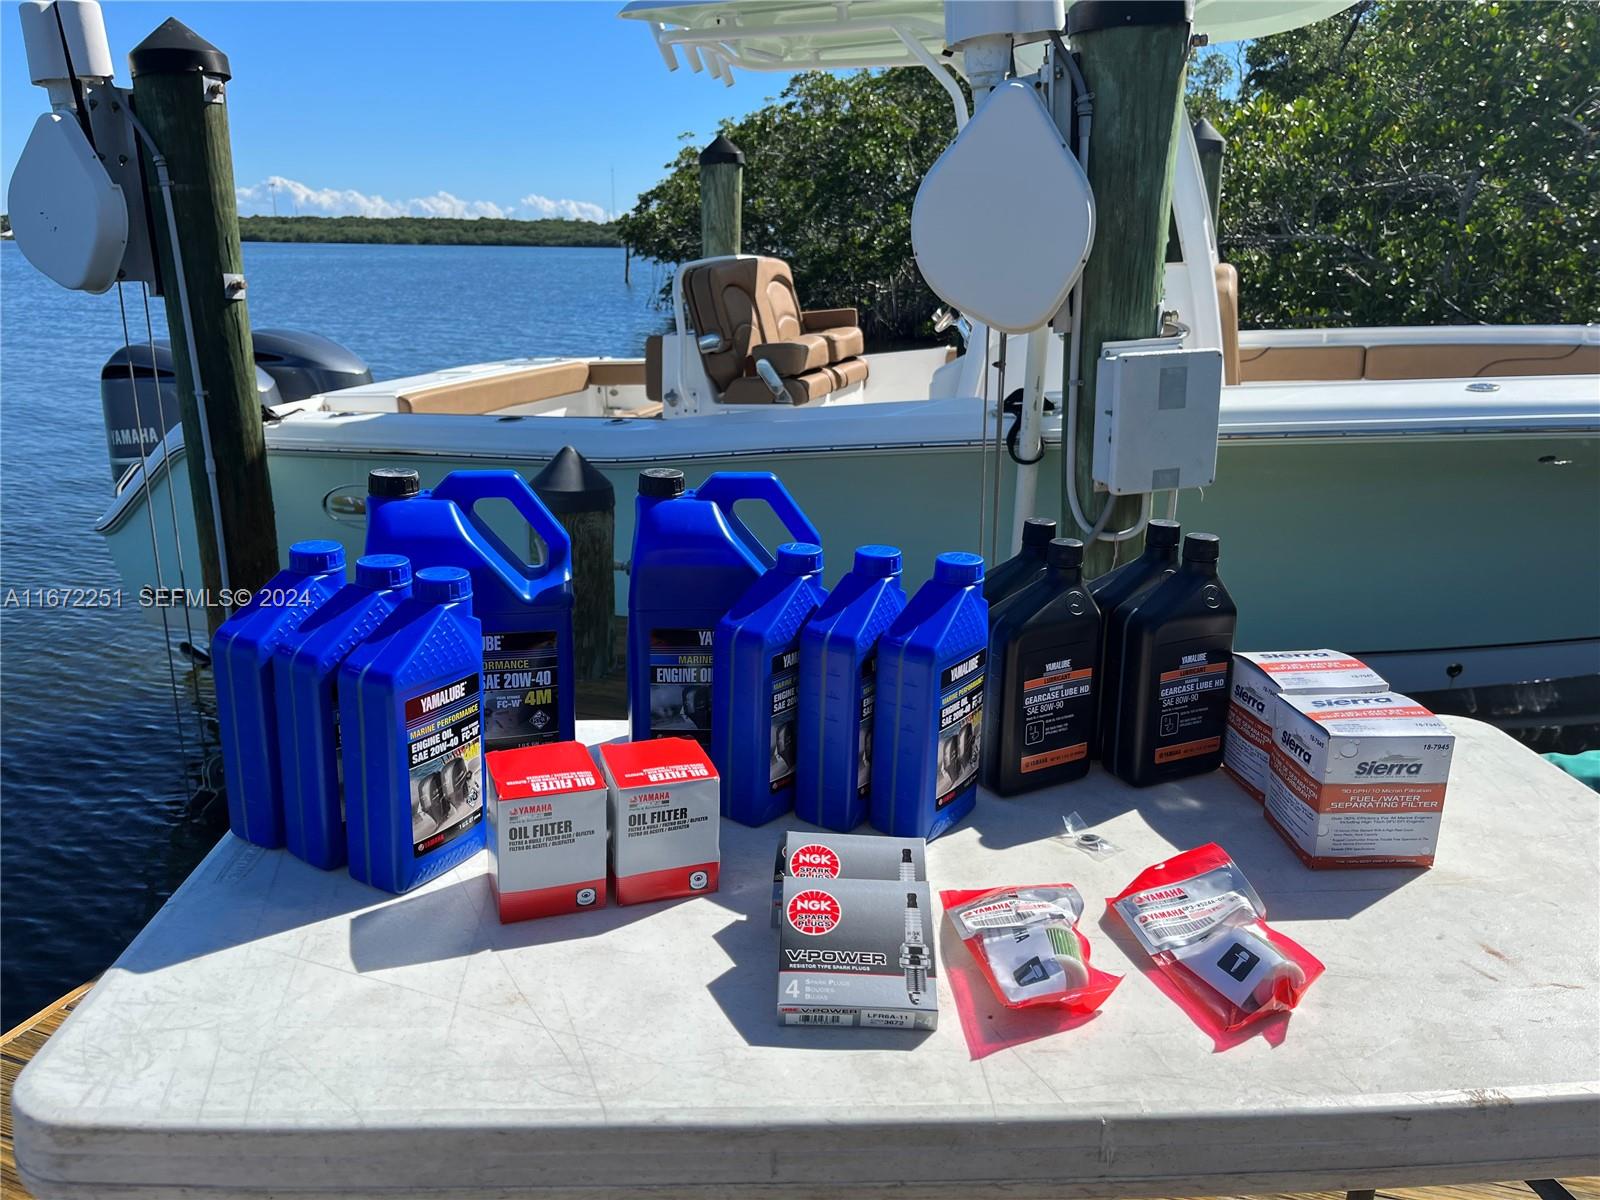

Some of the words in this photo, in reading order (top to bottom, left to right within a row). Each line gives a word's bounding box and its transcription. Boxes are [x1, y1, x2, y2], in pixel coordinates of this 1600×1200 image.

[110, 427, 158, 445] YAMAHA
[678, 655, 713, 665] MARINE
[1045, 659, 1071, 672] YAMALUBE
[1182, 652, 1207, 665] YAMALUBE
[656, 668, 697, 683] ENGINE
[950, 656, 979, 682] YAMALUBE
[503, 670, 552, 688] 20W-40
[1024, 691, 1060, 706] GEARCASE
[1060, 686, 1078, 698] LUBE
[1079, 684, 1090, 694] HD
[1160, 683, 1195, 697] GEARCASE
[1195, 680, 1213, 690] LUBE
[1214, 678, 1225, 687] HD
[420, 681, 466, 713] YAMALUBE
[524, 688, 552, 706] 4M
[1163, 698, 1174, 707] SAE
[1175, 693, 1199, 705] 80W-90
[1234, 684, 1266, 713] Sierra
[1311, 696, 1392, 708] Sierra
[1026, 706, 1039, 716] SAE
[1039, 701, 1064, 713] 80W-90
[410, 724, 435, 740] MARINE
[437, 703, 479, 729] PERFORMANCE
[411, 734, 442, 755] ENGINE
[442, 728, 454, 741] OIL
[1281, 731, 1312, 765] Sierra
[412, 749, 429, 765] SAE
[430, 736, 459, 758] 20W-40
[688, 769, 709, 777] OIL
[1354, 761, 1423, 776] Sierra
[575, 776, 597, 787] OIL
[648, 771, 688, 782] FILTER
[530, 778, 574, 792] FILTER
[638, 792, 670, 803] YAMAHA
[518, 803, 553, 815] YAMAHA
[628, 814, 648, 827] OIL
[650, 807, 688, 824] FILTER
[508, 826, 530, 841] OIL
[532, 820, 573, 838] FILTER
[799, 854, 831, 865] NGK
[1143, 888, 1185, 901] YAMAHA
[797, 900, 831, 911] NGK
[973, 902, 1011, 915] YAMAHA
[1147, 908, 1185, 920] YAMAHA
[785, 949, 887, 965] V-POWER
[785, 979, 800, 998] 4
